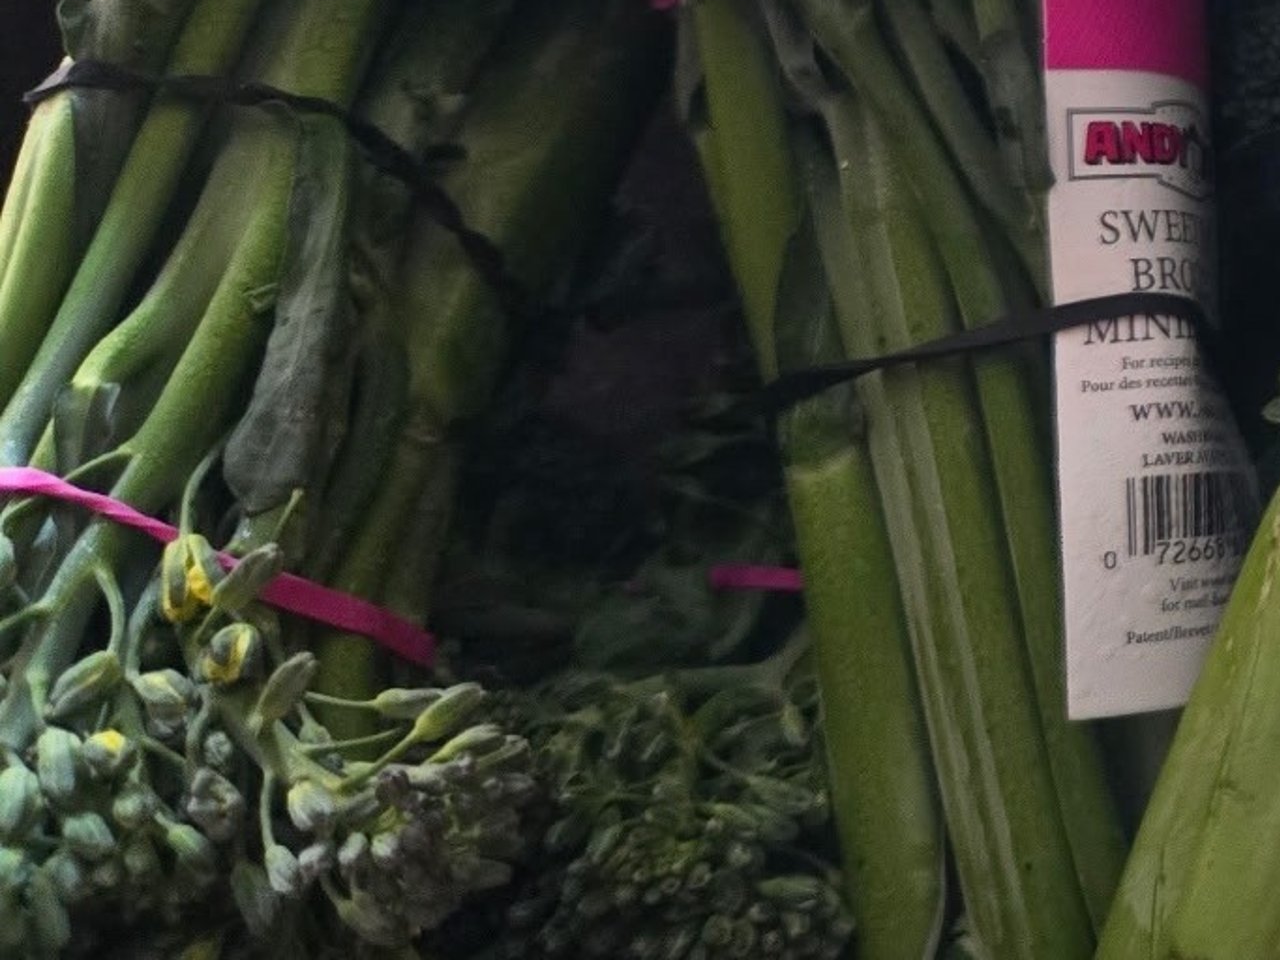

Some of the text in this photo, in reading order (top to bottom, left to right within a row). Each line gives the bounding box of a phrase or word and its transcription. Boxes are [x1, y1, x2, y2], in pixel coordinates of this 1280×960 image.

[1099, 209, 1198, 245] SWEE
[1081, 379, 1115, 393] Pour
[1104, 551, 1117, 570] 0
